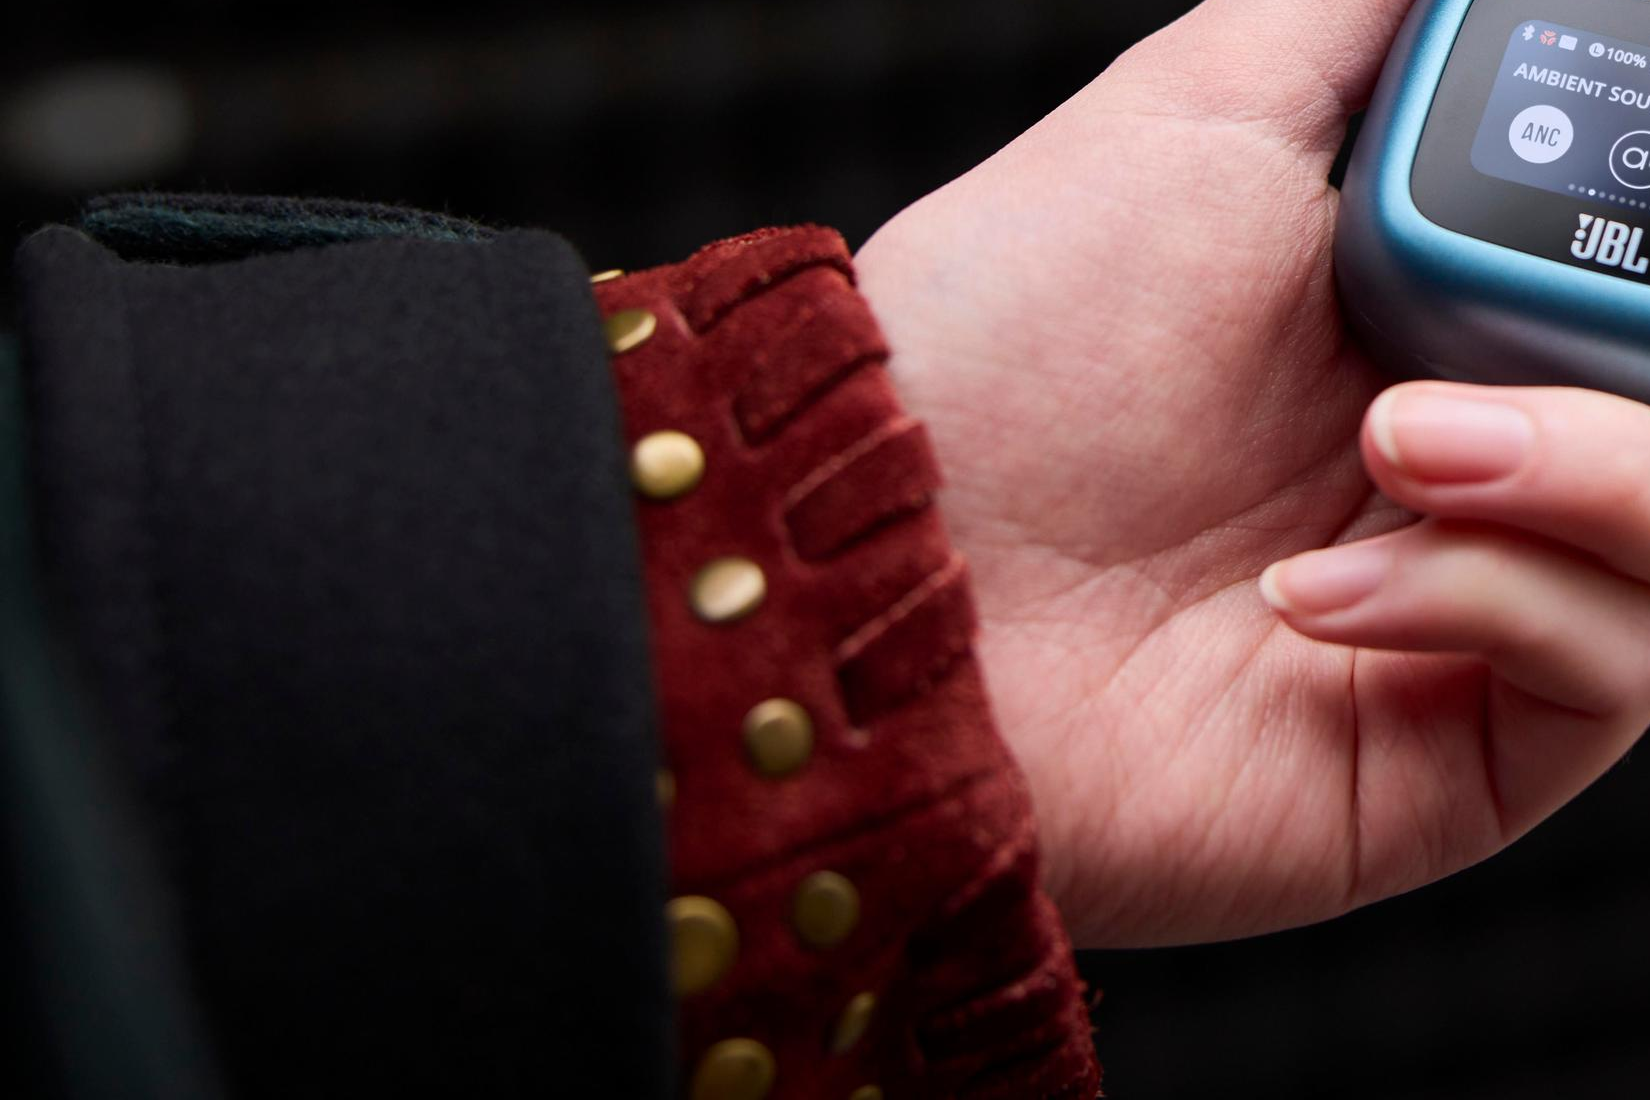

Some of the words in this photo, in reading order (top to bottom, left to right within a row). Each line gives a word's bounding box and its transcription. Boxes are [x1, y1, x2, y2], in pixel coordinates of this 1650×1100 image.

[1606, 47, 1647, 68] 100%
[1513, 62, 1606, 98] AMBIENT
[1521, 121, 1561, 147] ANC
[1570, 213, 1649, 275] JBL
